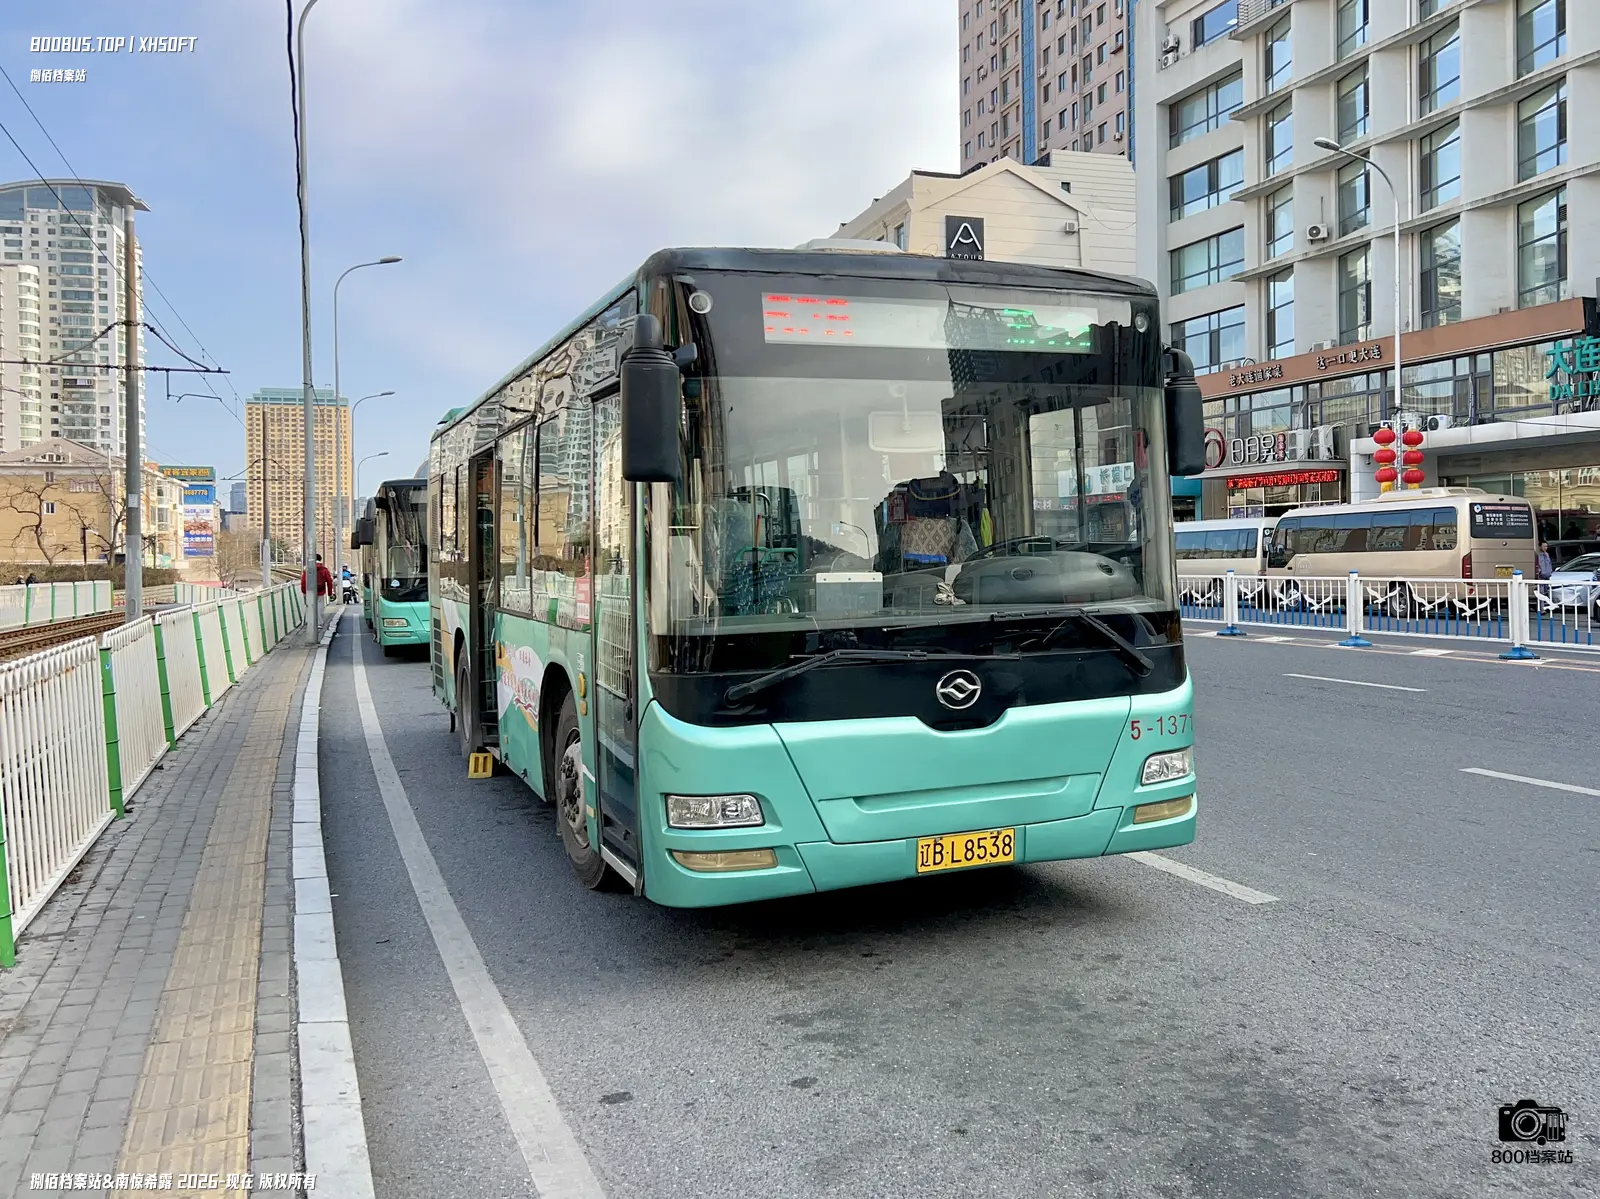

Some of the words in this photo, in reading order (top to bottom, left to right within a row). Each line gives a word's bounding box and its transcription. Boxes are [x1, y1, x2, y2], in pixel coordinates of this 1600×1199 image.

[1316, 345, 1381, 370] 这一口更大连
